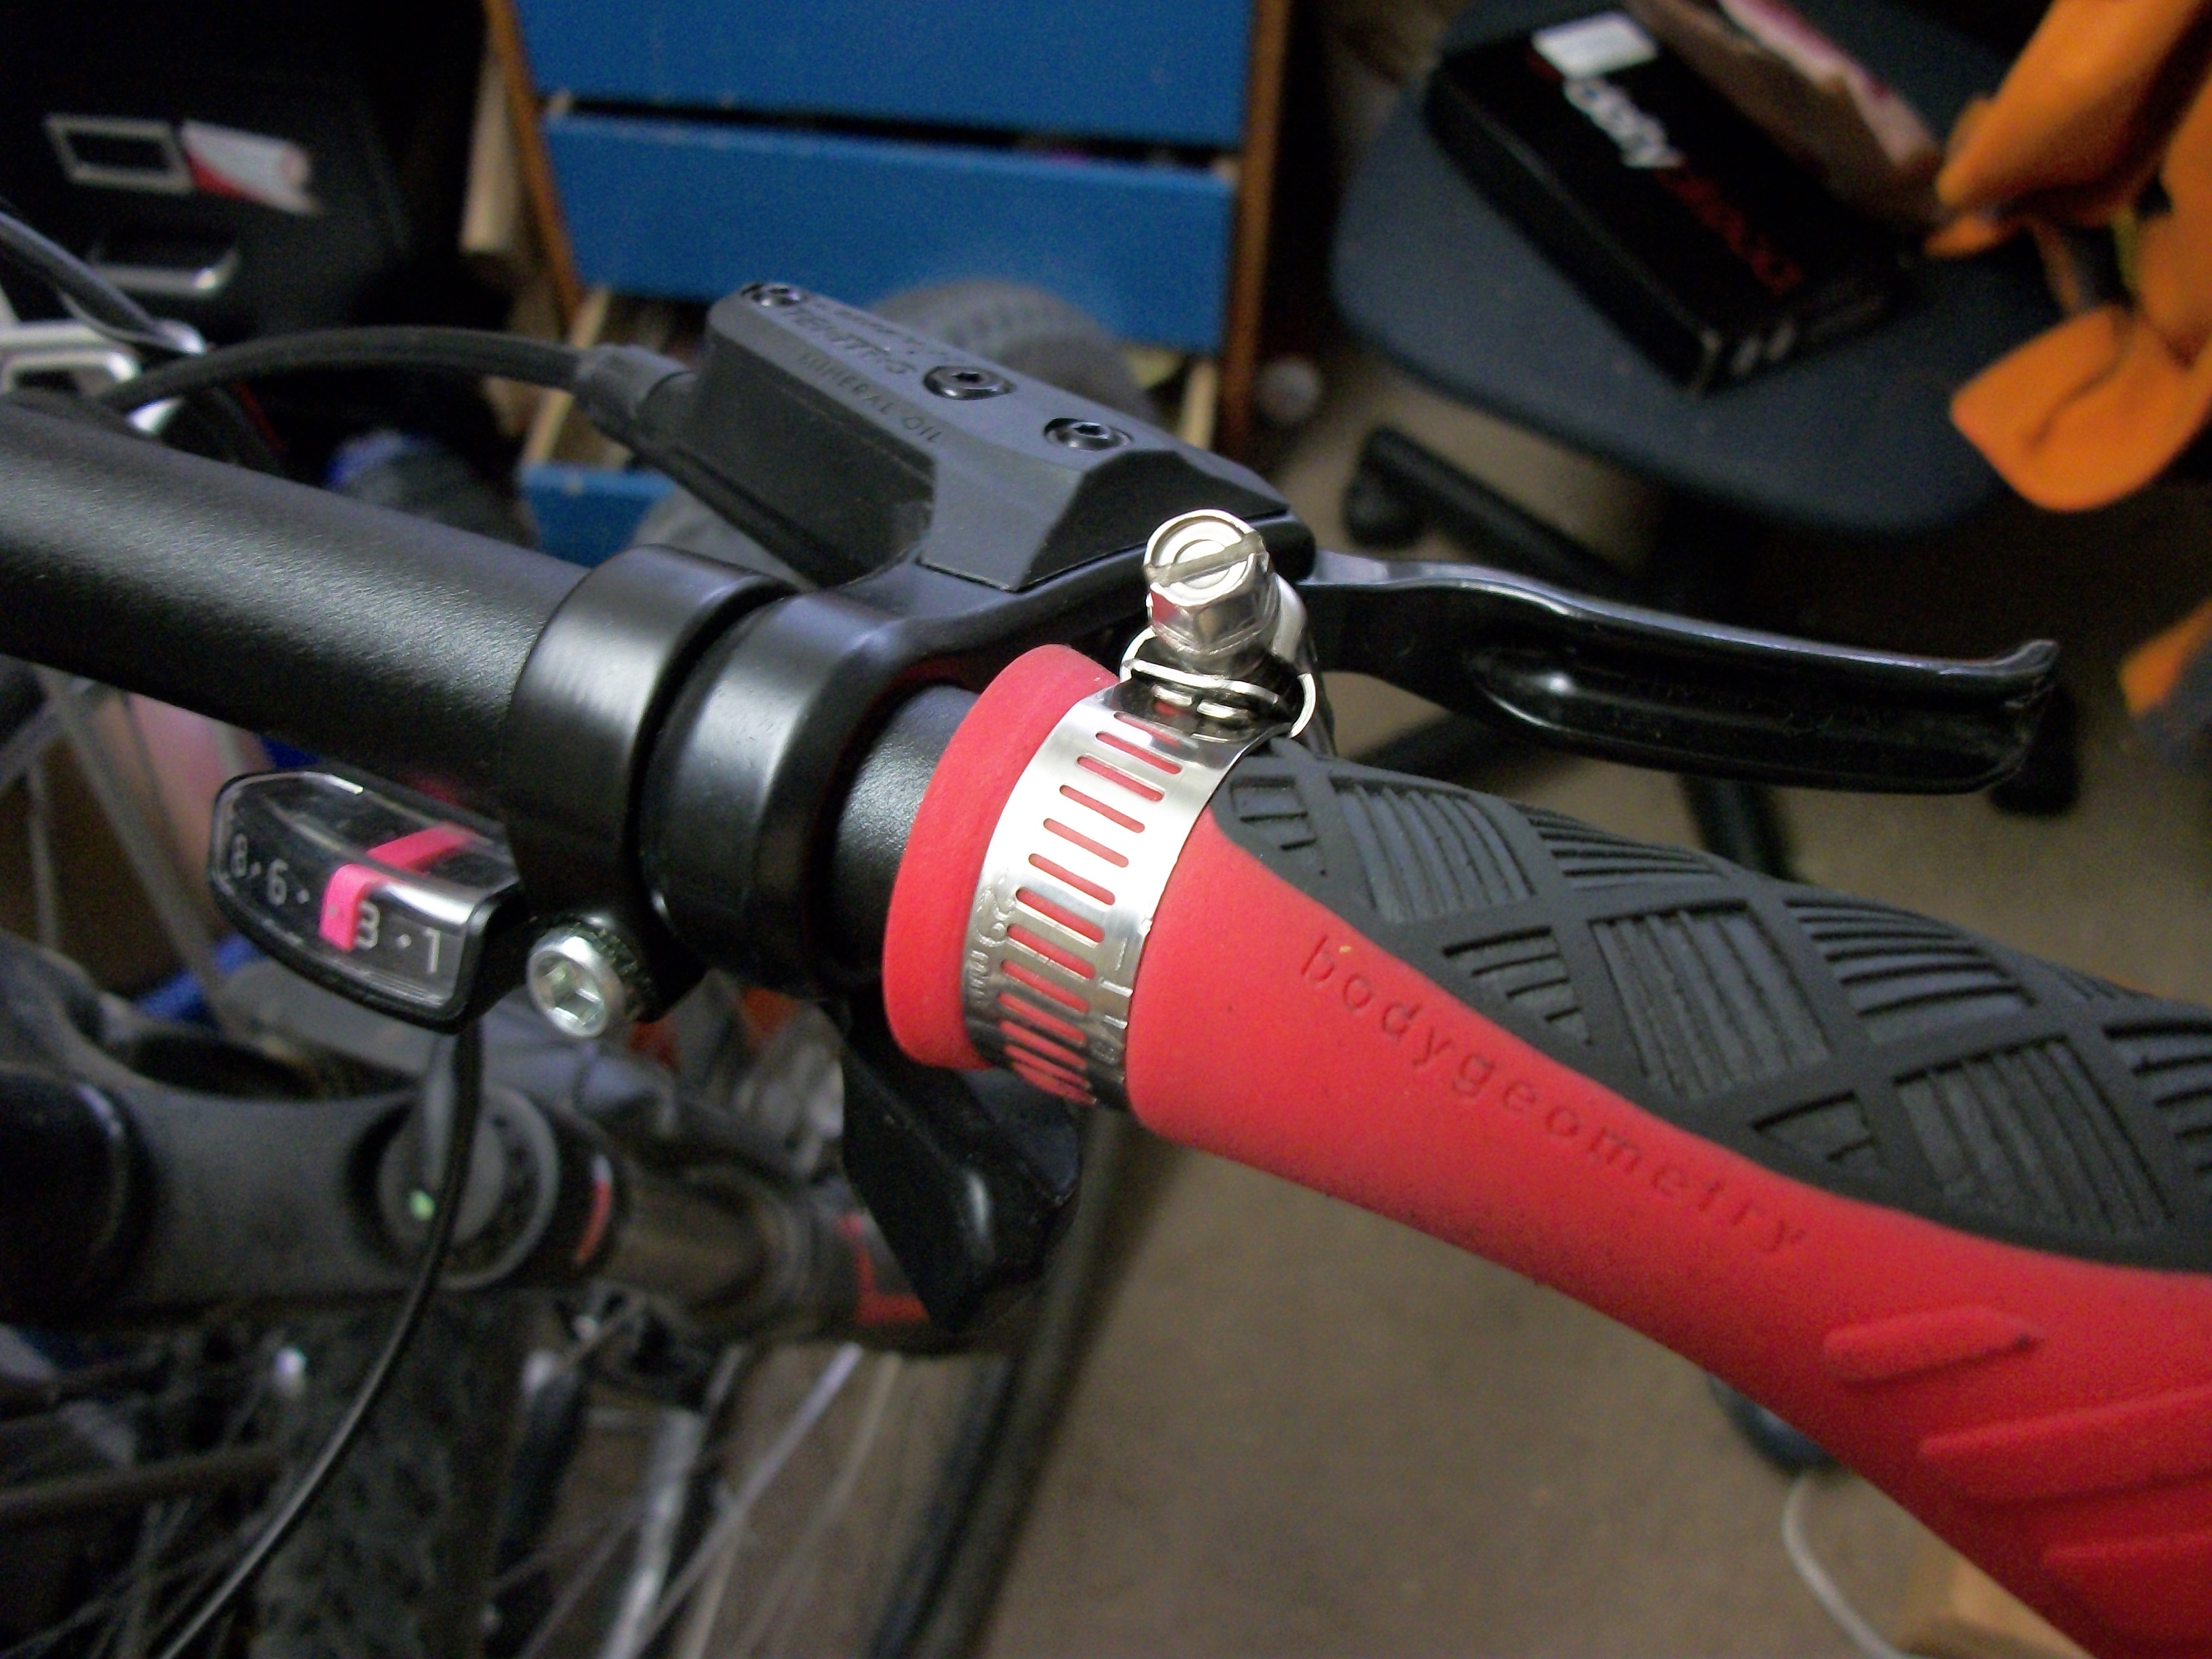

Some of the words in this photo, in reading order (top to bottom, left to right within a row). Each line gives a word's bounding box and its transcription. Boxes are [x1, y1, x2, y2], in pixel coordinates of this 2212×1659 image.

[796, 350, 894, 414] MINERAL
[902, 415, 942, 441] OIL
[267, 858, 288, 906] 6
[424, 927, 441, 974] 1
